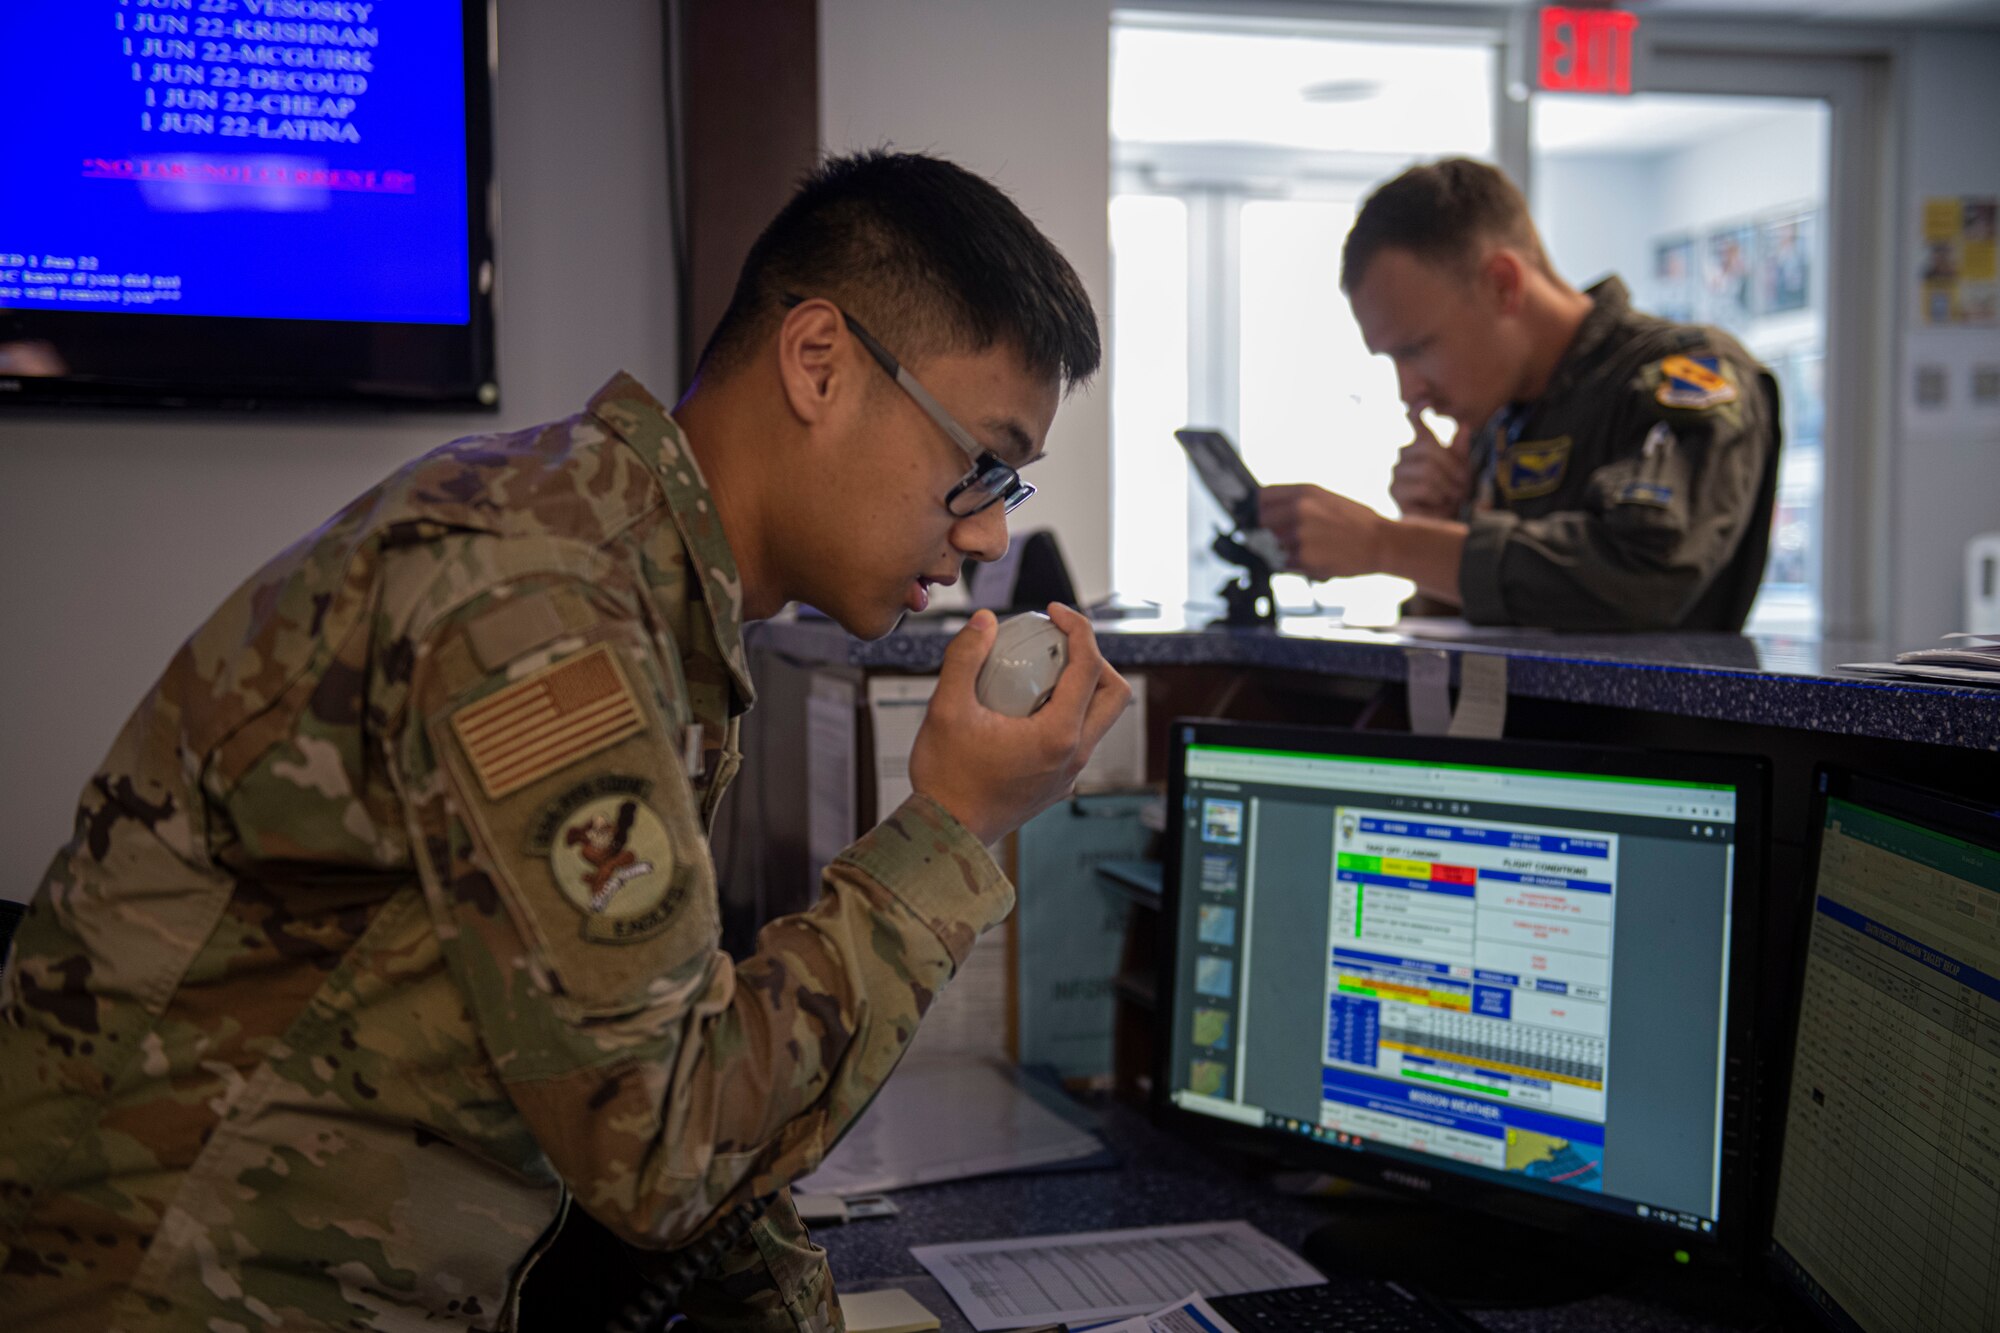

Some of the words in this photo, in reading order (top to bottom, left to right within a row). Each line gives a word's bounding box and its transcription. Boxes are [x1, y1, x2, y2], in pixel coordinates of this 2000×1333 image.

[115, 12, 125, 31] 1
[133, 13, 188, 35] JUN
[123, 37, 133, 56] 1
[141, 37, 195, 60] JUN
[1539, 6, 1639, 96] EXIT
[131, 62, 141, 81] 1
[149, 62, 204, 85] JUN
[146, 87, 156, 107] 1
[163, 88, 218, 110] JUN
[141, 111, 152, 131] 1
[159, 112, 214, 135] JUN
[1503, 857, 1533, 870] FLIGHT
[1535, 861, 1588, 877] CONDITIONS
[1450, 1097, 1501, 1120] WEATHER
